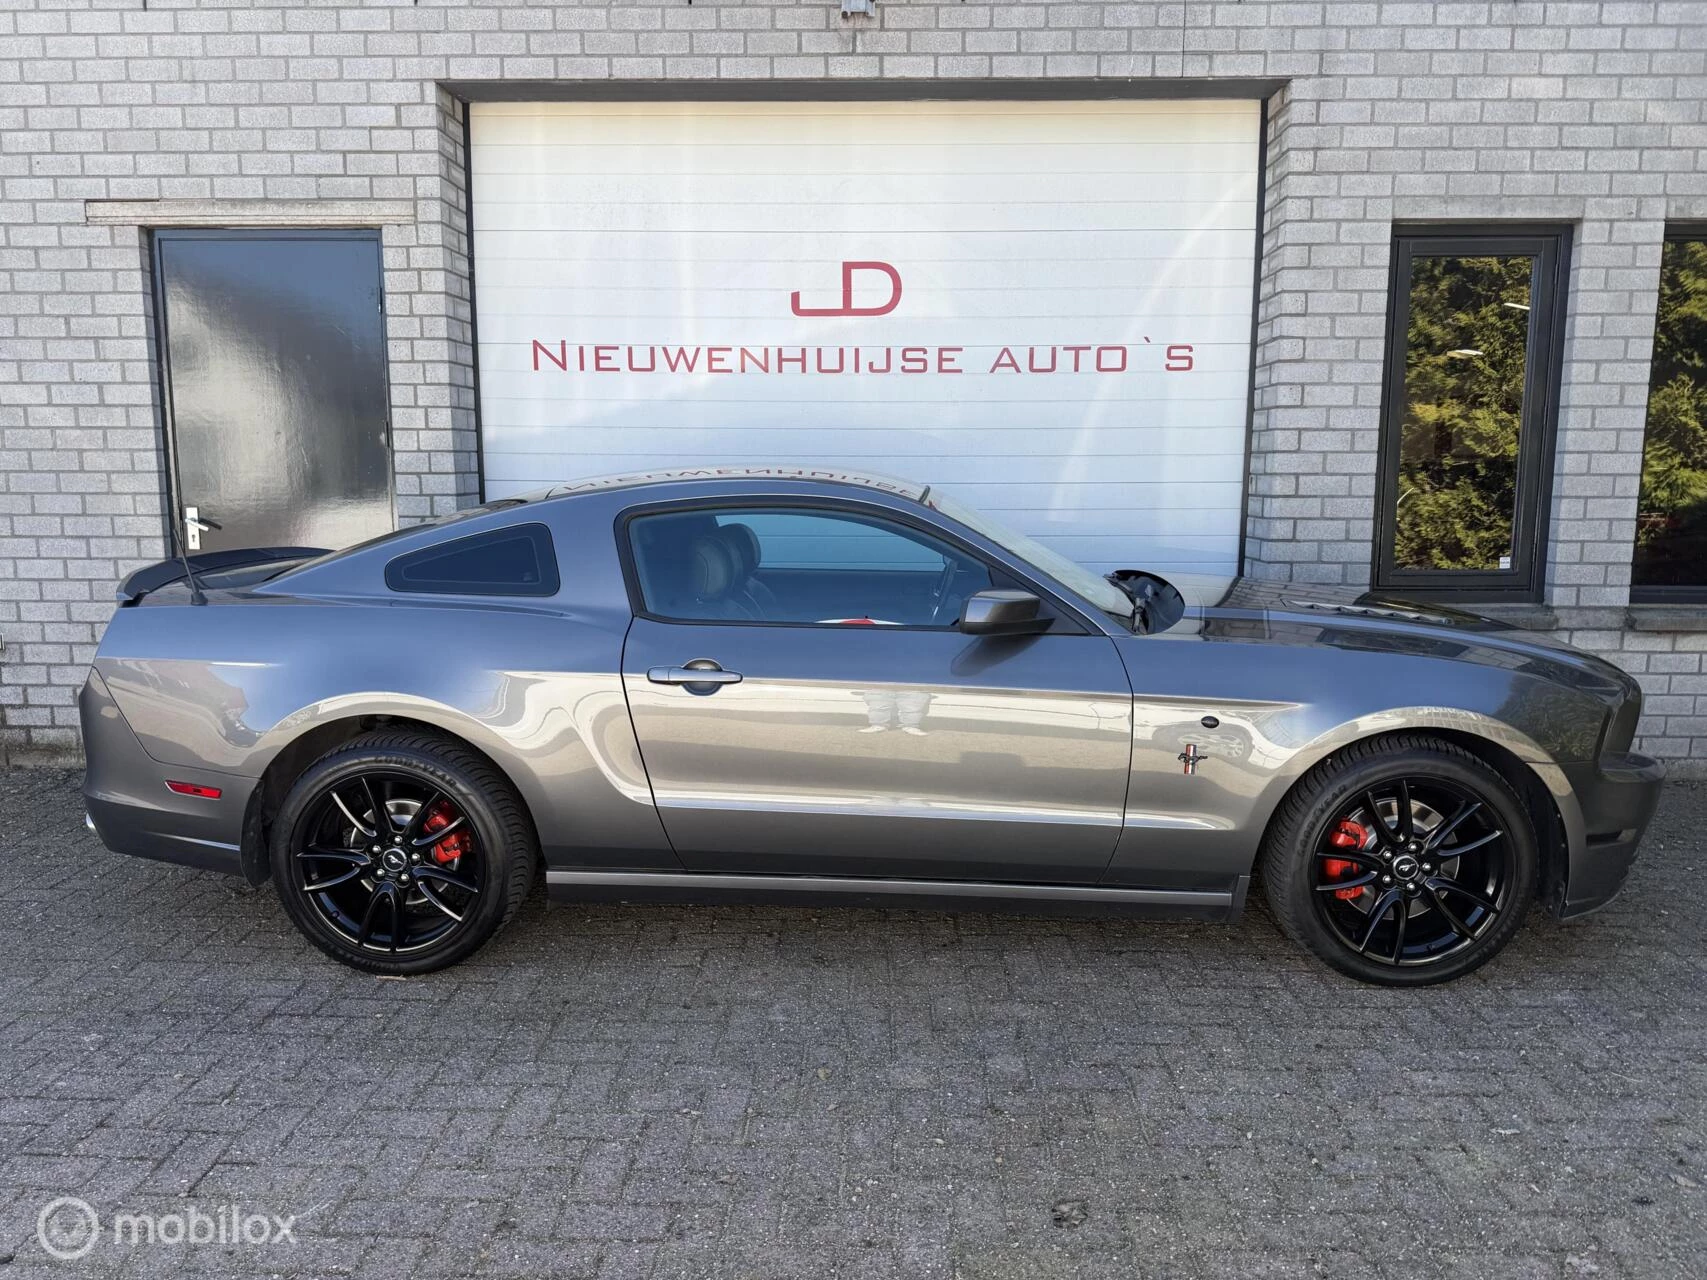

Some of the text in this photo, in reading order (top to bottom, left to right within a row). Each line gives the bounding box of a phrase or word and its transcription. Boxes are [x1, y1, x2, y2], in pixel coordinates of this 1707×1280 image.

[790, 260, 903, 317] JD
[531, 339, 963, 375] NIEUWENHUIJSE
[373, 755, 458, 788] GOODYEAR
